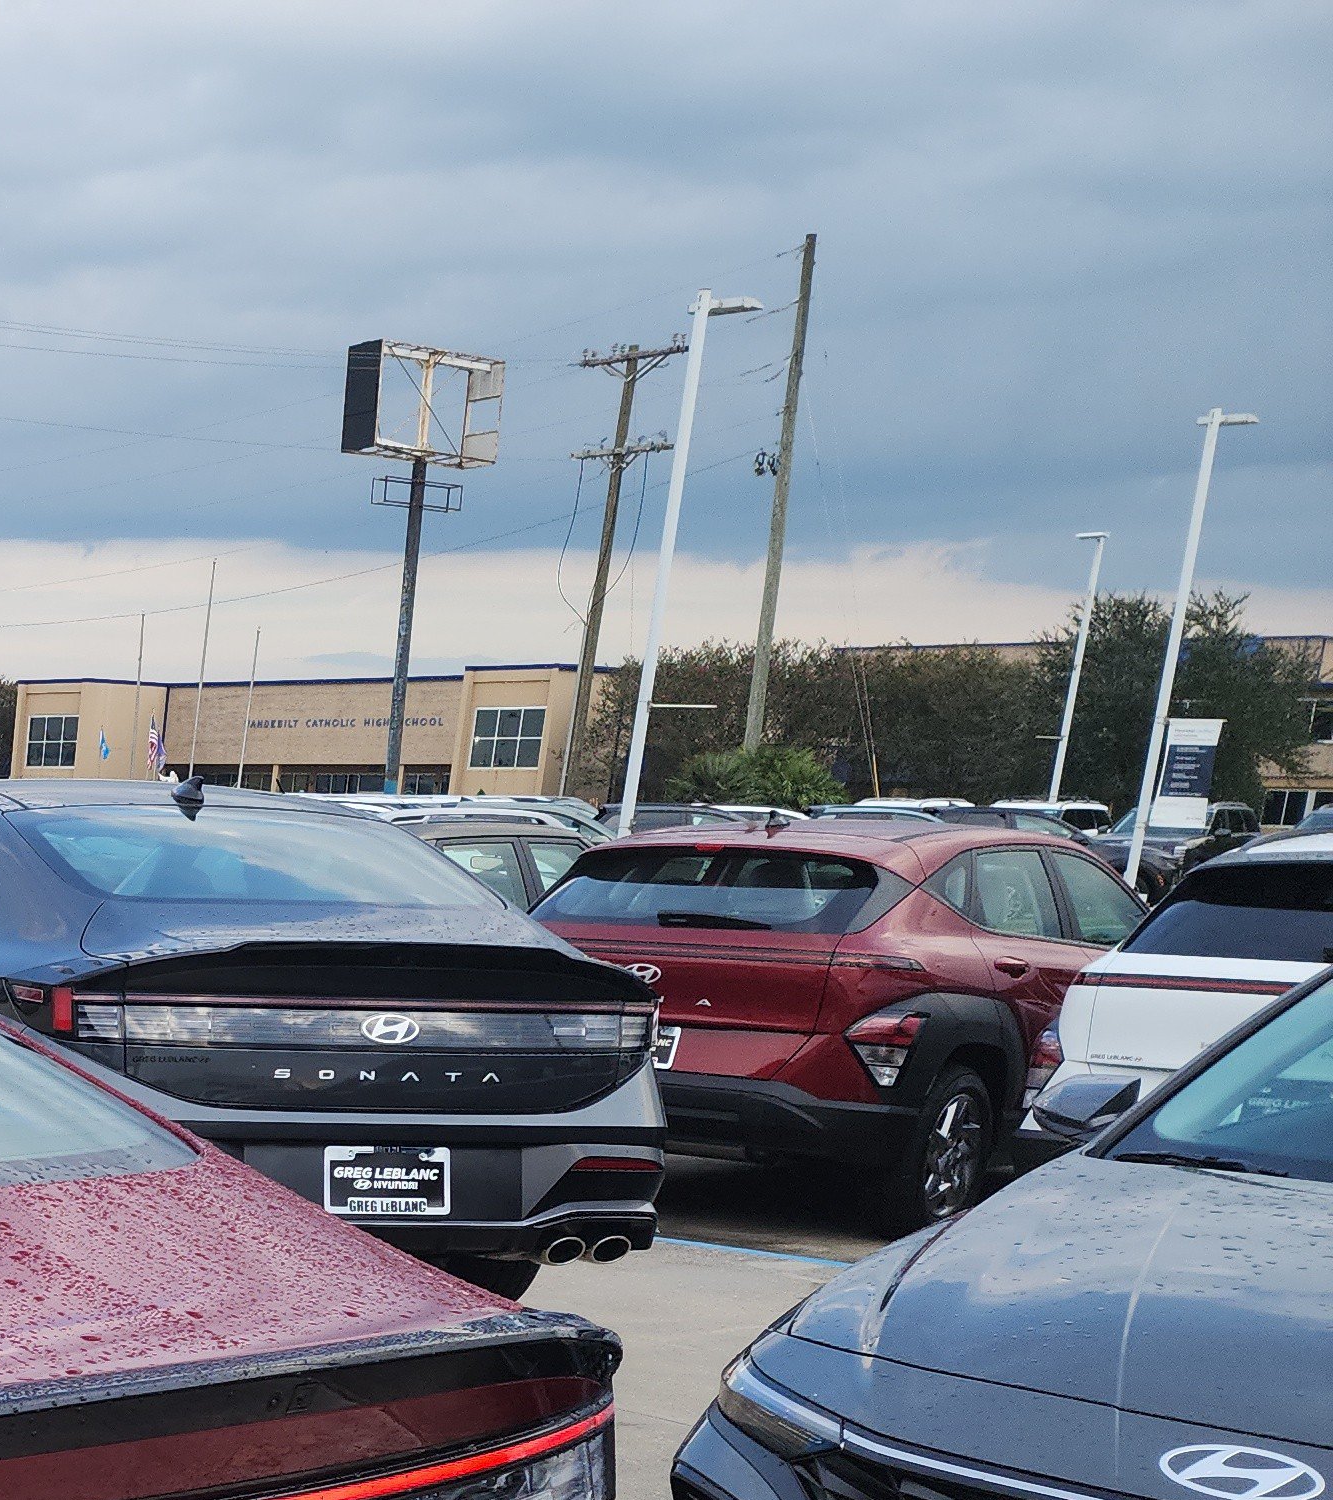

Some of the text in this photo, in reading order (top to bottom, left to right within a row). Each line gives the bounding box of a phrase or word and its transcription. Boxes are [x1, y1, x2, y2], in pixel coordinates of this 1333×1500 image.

[305, 718, 356, 728] CATHOLIC
[363, 717, 390, 727] HIGH
[404, 717, 444, 727] CHOOL
[273, 1068, 500, 1083] SONATA
[333, 1166, 440, 1180] GREG LEBLANC
[373, 1180, 418, 1190] HYUNDAI
[349, 1199, 377, 1213] GREG
